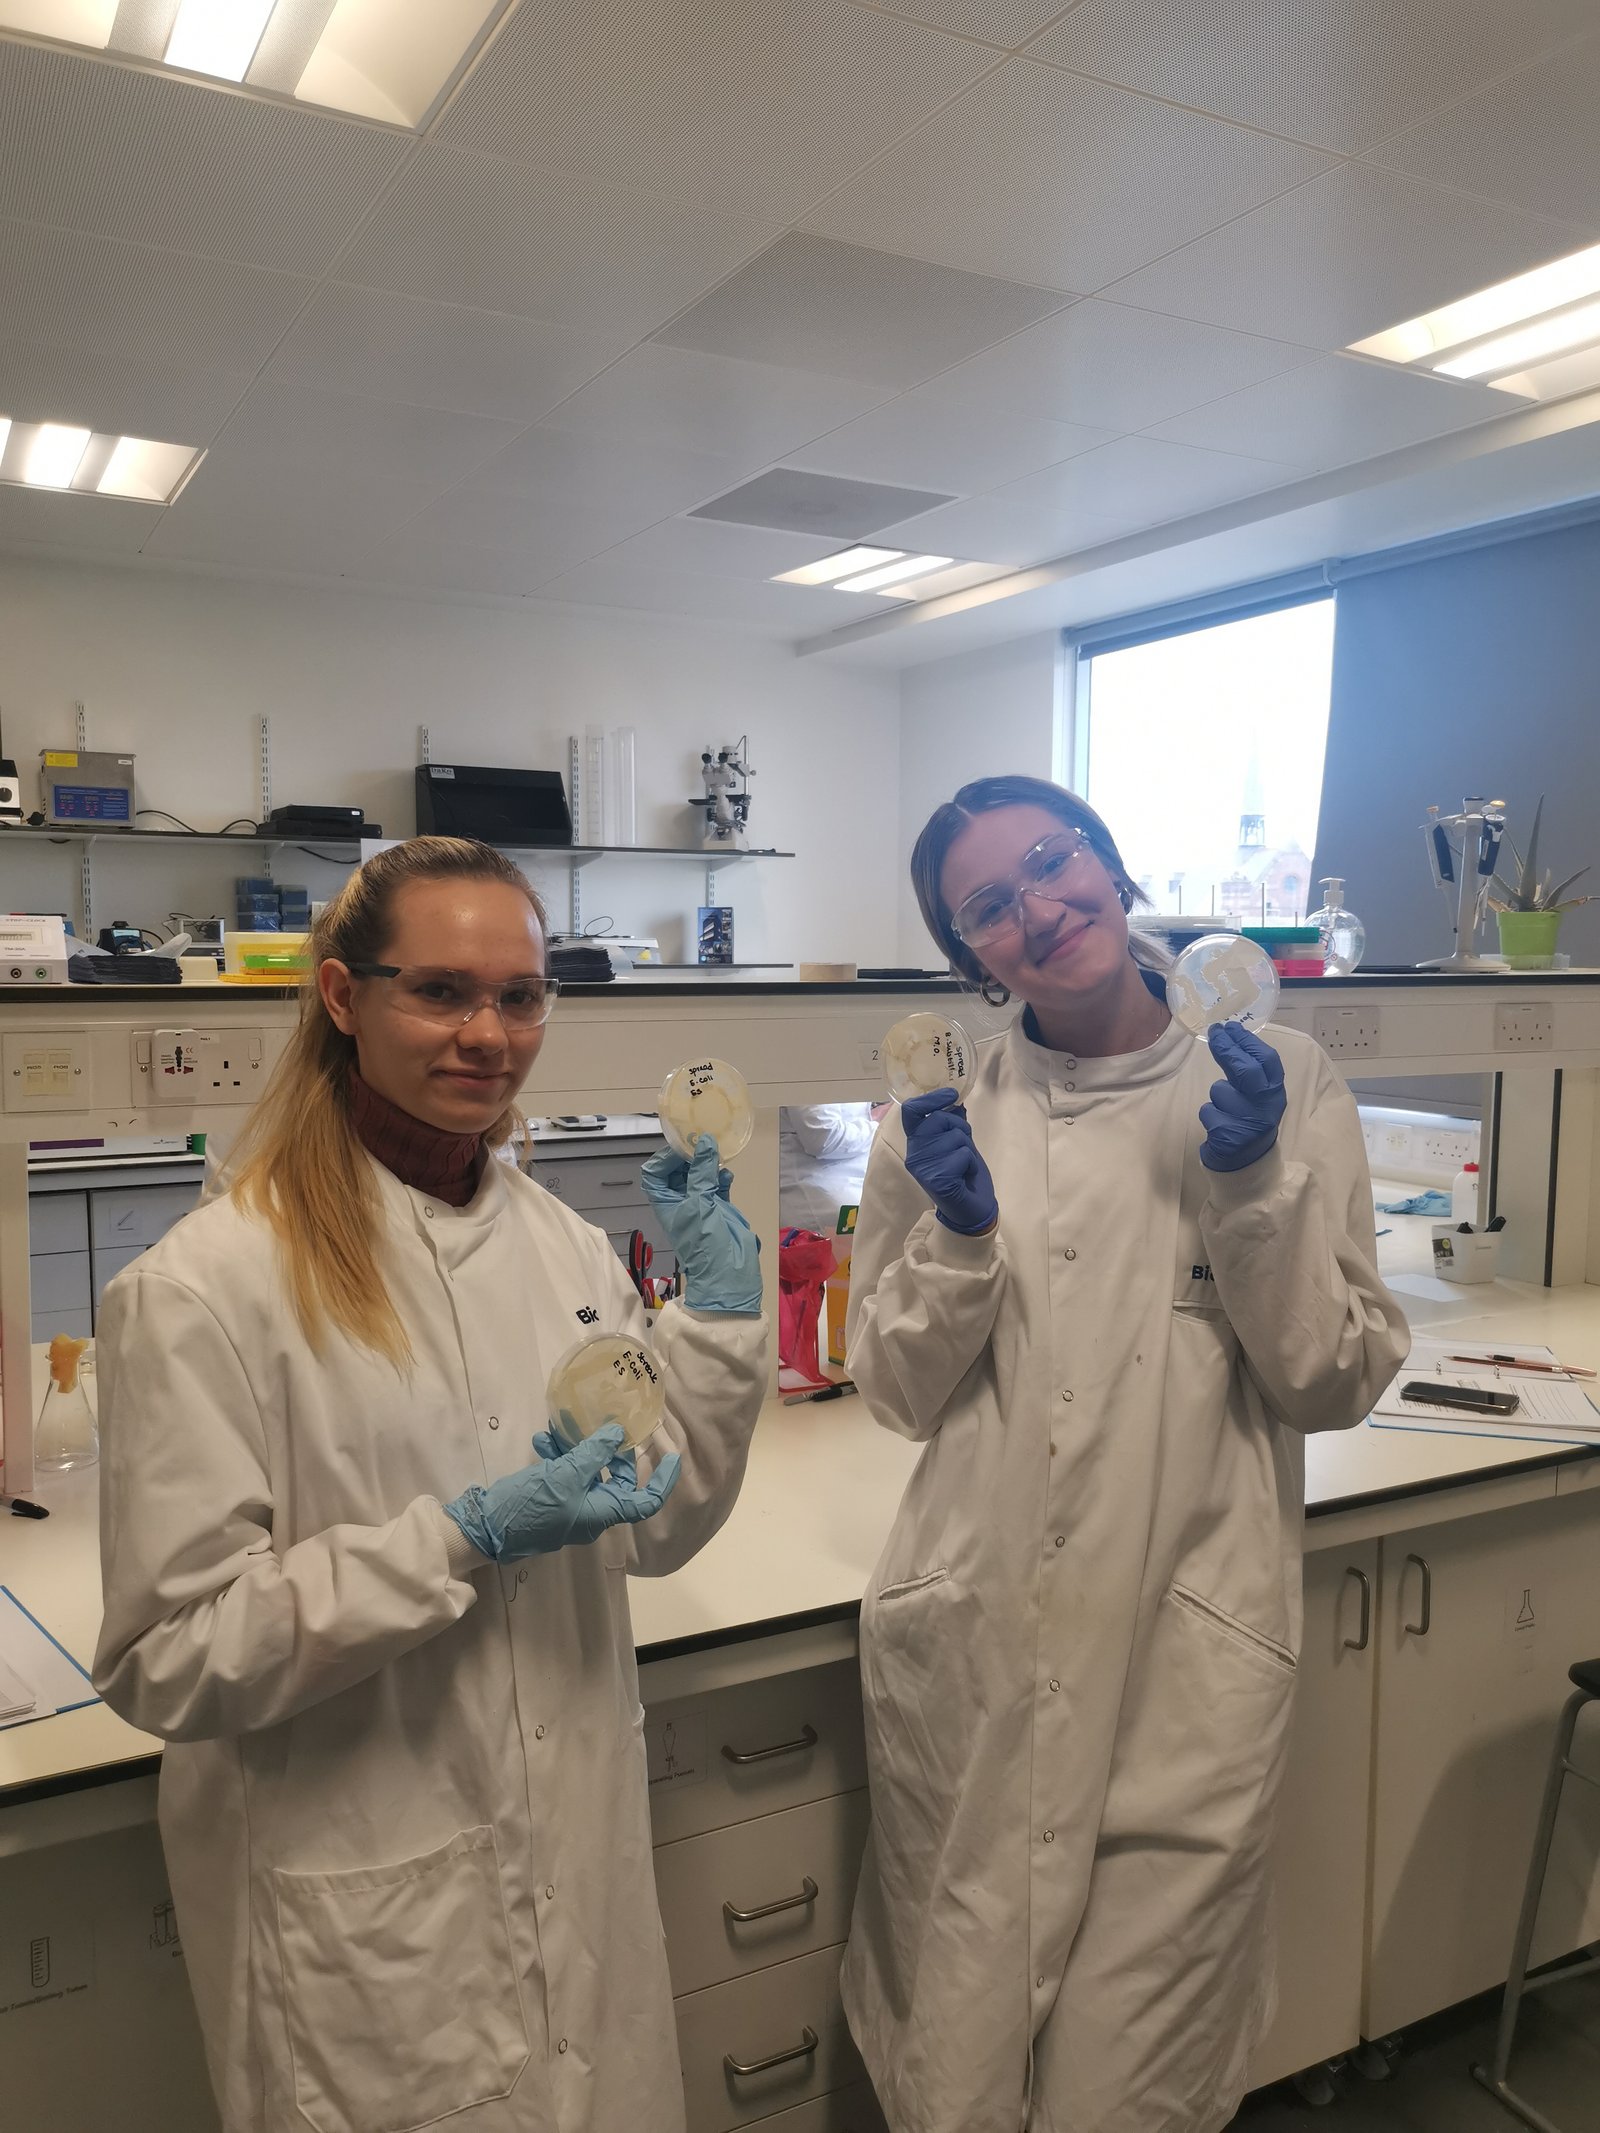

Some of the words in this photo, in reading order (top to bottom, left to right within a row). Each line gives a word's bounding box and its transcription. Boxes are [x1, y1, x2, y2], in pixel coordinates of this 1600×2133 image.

[872, 1049, 879, 1061] 2
[954, 1045, 966, 1079] spread
[688, 1062, 714, 1077] spread
[1191, 1264, 1215, 1282] Bi
